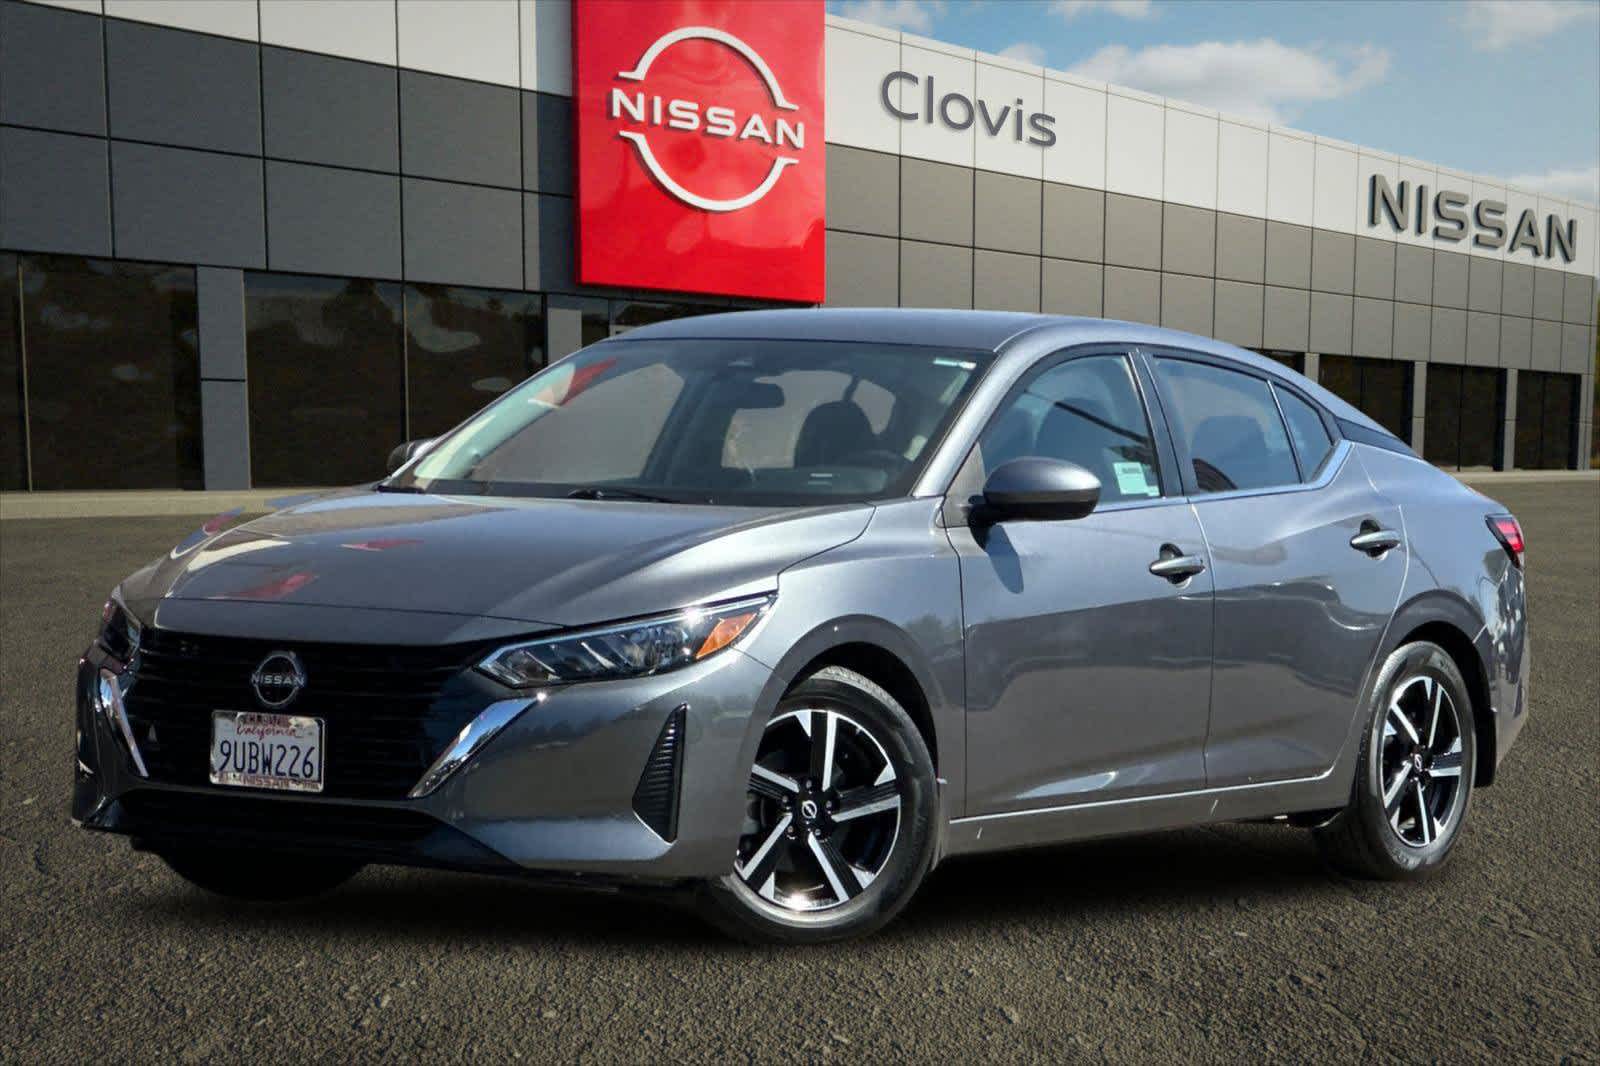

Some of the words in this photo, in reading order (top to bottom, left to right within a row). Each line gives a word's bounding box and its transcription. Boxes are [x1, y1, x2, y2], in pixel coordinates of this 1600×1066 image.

[610, 87, 805, 149] NISSAN
[881, 70, 1057, 147] Clovis
[1368, 173, 1578, 263] NISSAN
[250, 673, 305, 688] NISSAN
[219, 740, 316, 778] 9UBW226
